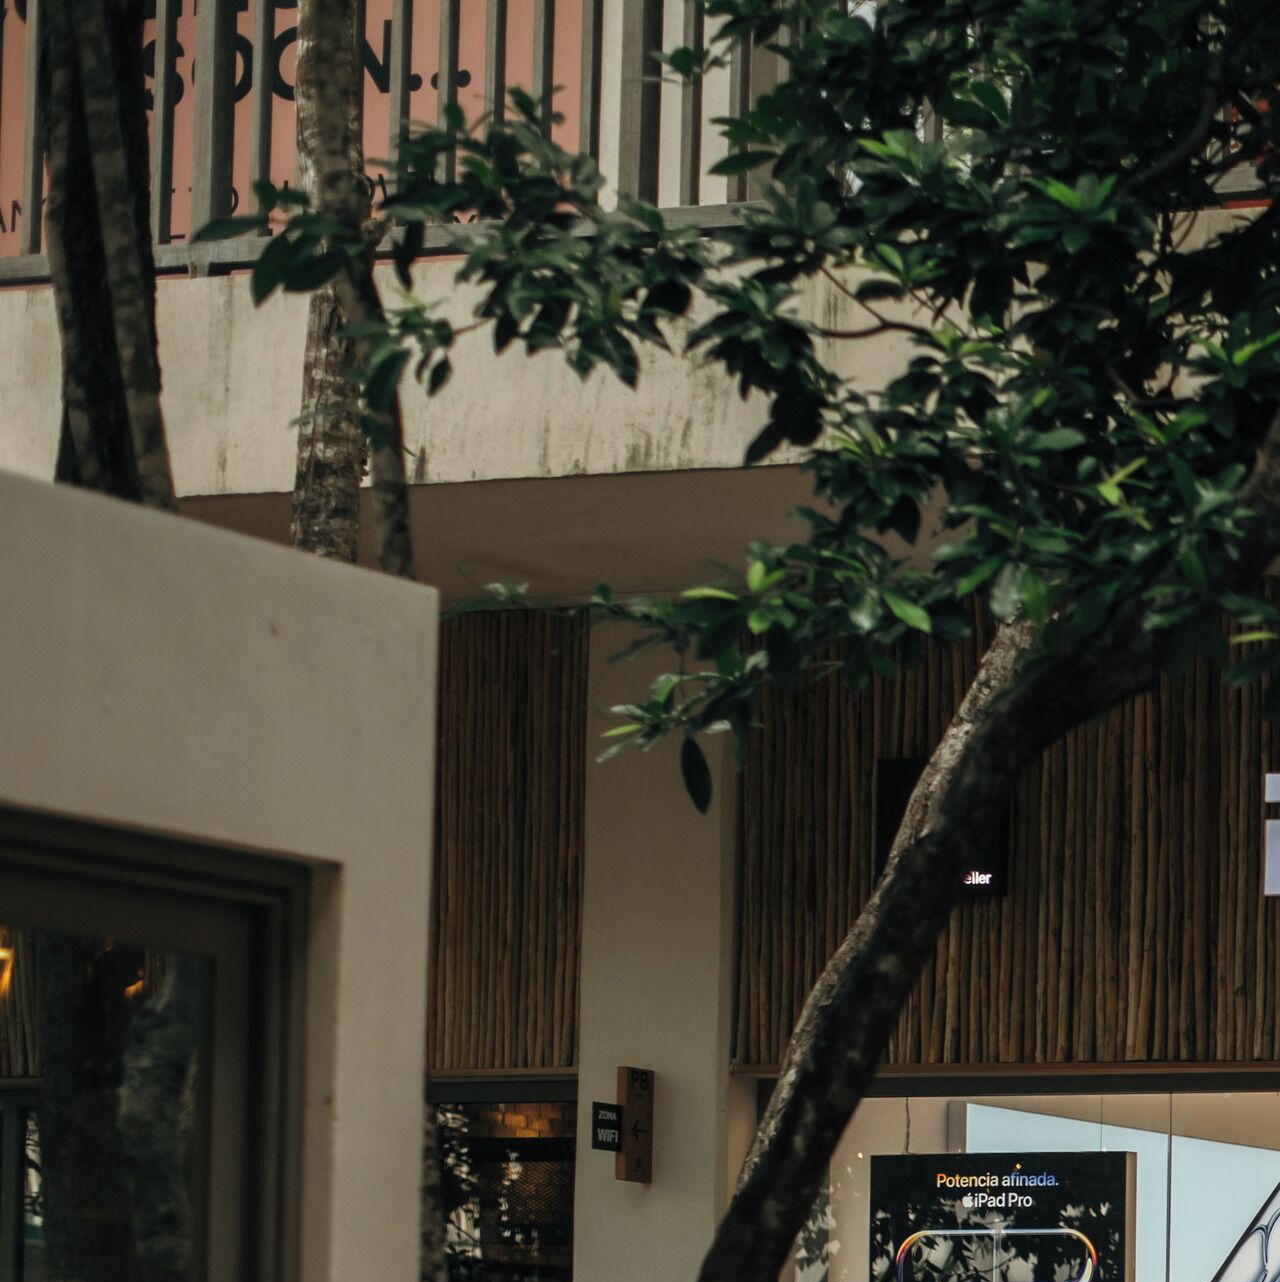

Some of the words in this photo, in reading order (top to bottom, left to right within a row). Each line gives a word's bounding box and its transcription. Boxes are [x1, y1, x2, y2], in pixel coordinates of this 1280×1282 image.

[598, 1110, 617, 1121] ZONA
[597, 1128, 619, 1143] WIFI
[936, 1172, 999, 1188] Potencia
[1001, 1172, 1060, 1187] afinada.
[974, 1192, 1006, 1207] iPad
[1008, 1192, 1033, 1207] Pro
